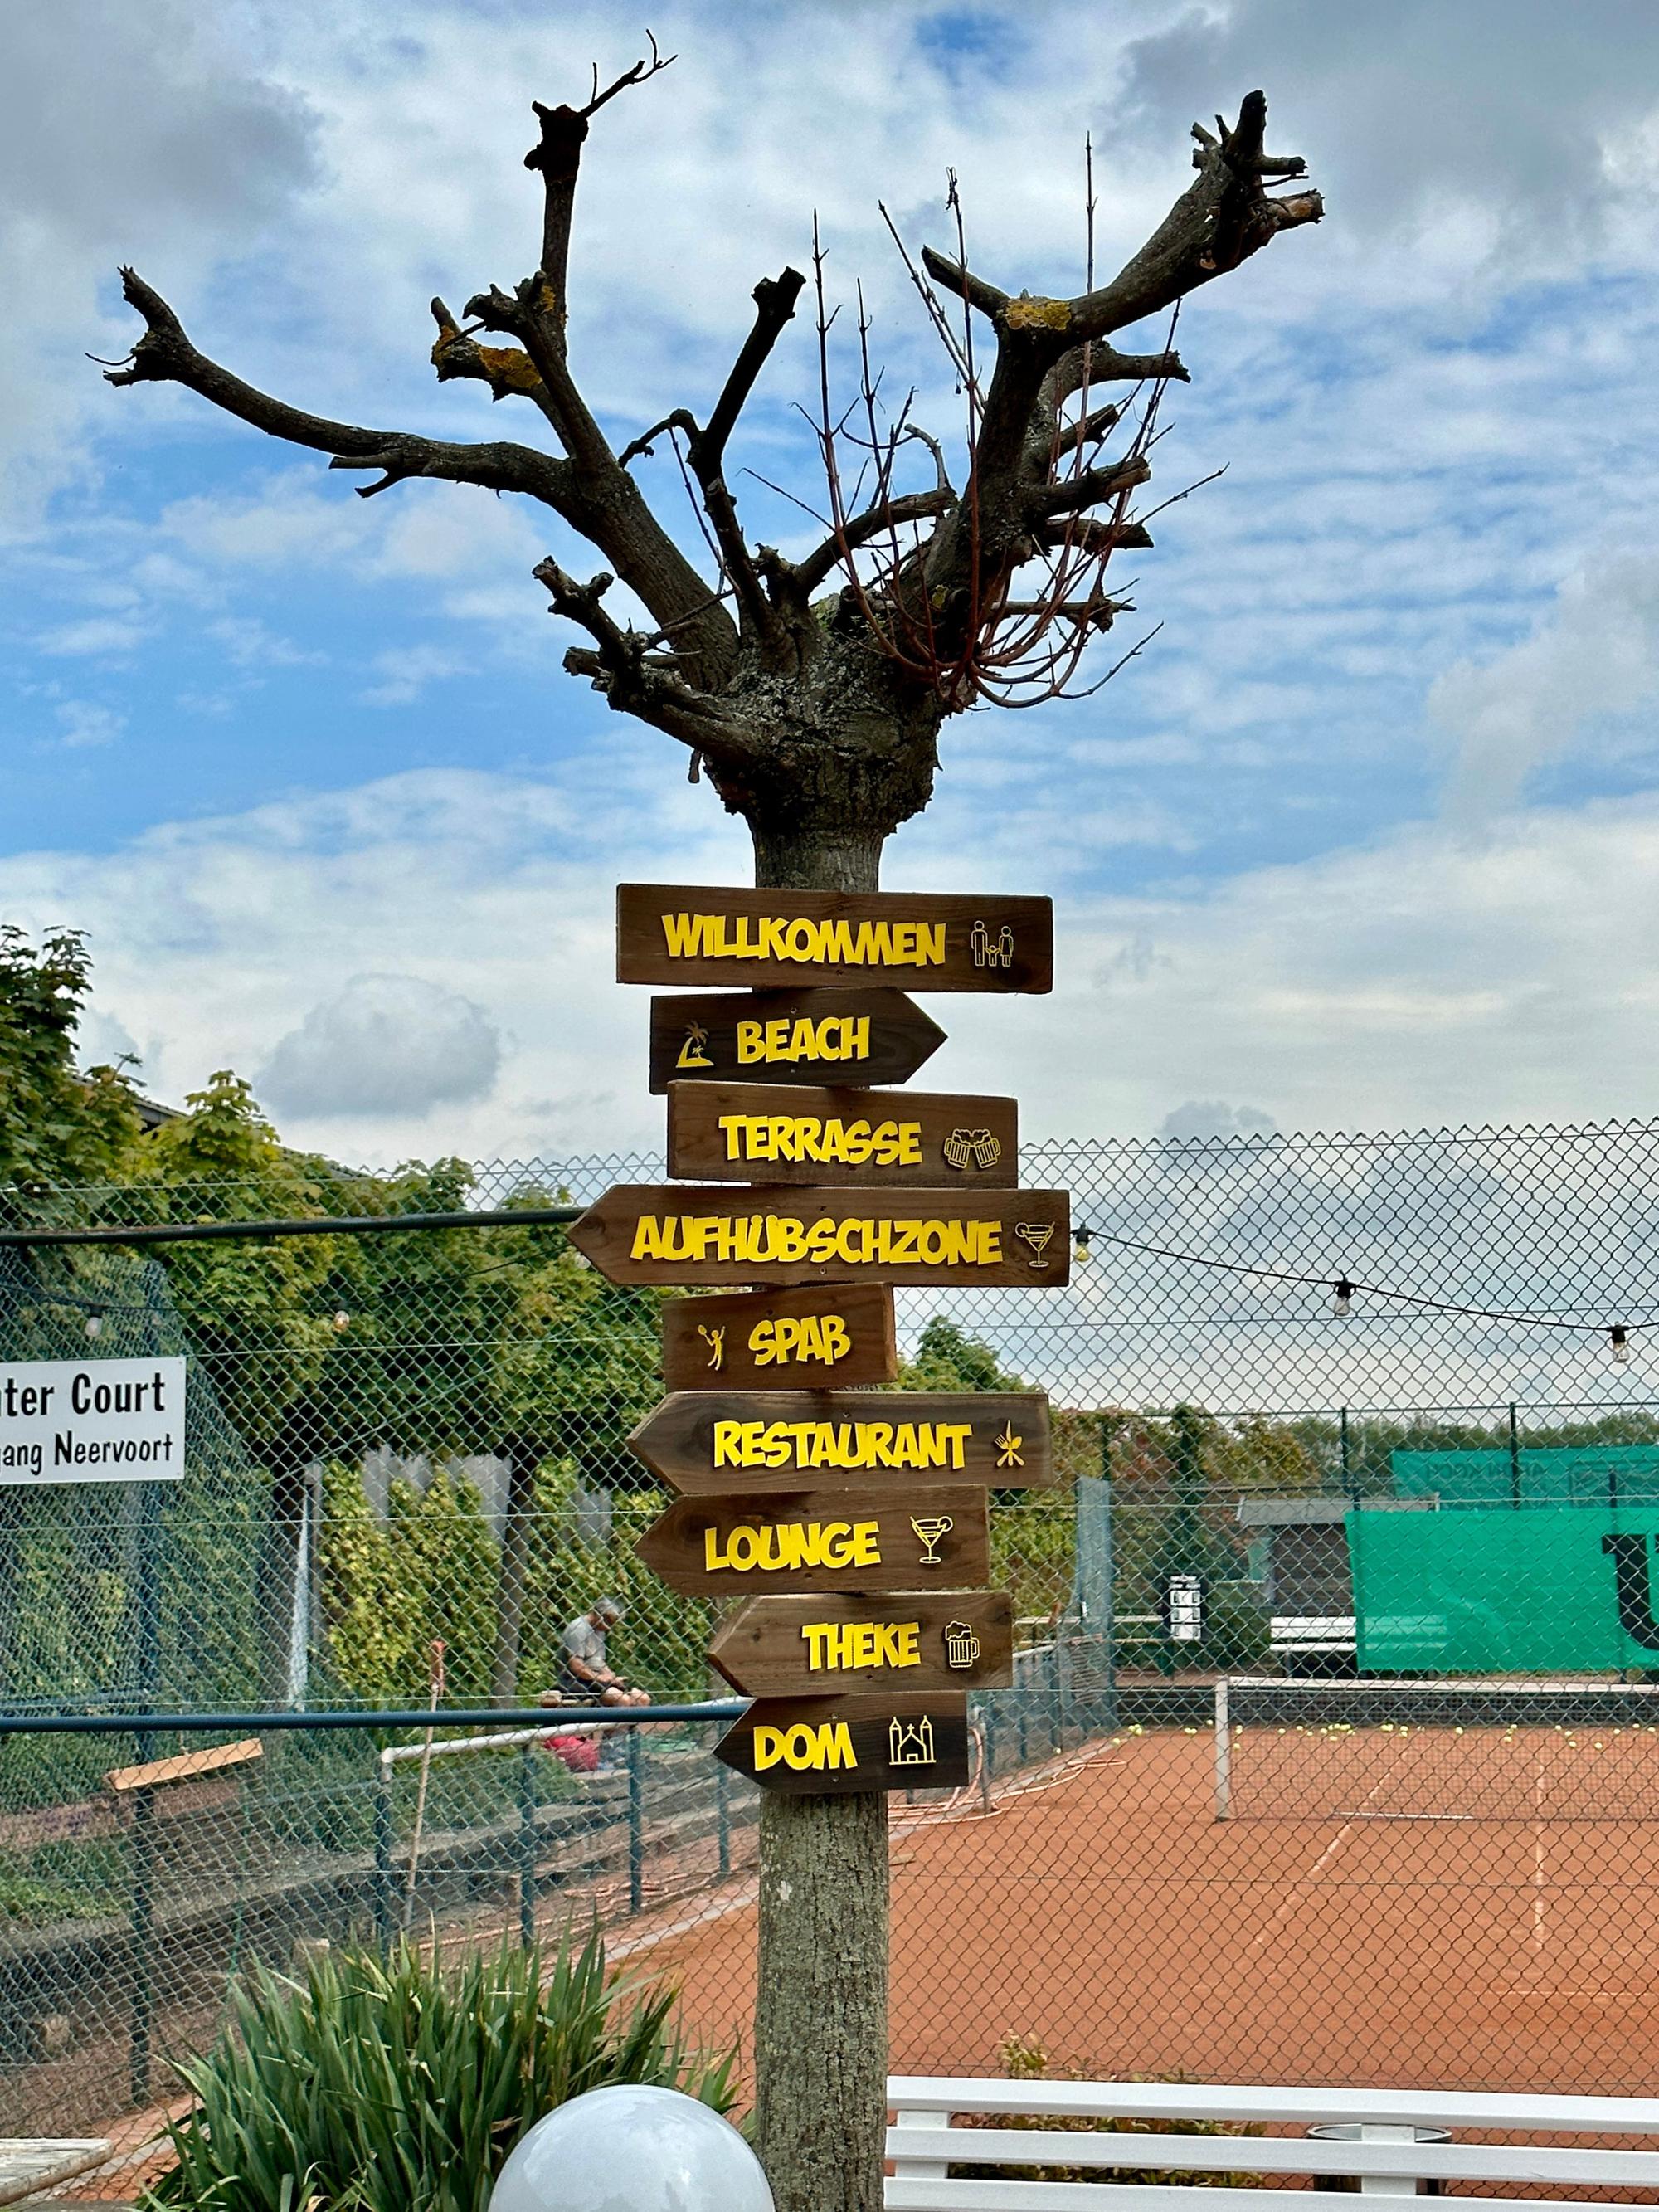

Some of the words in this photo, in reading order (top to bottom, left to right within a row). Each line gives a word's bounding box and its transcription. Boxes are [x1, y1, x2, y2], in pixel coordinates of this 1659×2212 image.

[661, 913, 946, 967] WILLKOMMEN
[737, 1016, 870, 1064] BEACH
[718, 1114, 923, 1166] TERRASSE
[630, 1214, 1002, 1265] AUFHÜBSCHZONE
[0, 1377, 55, 1417] ter
[71, 1372, 165, 1415] Court
[0, 1444, 42, 1476] ang
[54, 1430, 173, 1466] Neervoort
[714, 1420, 972, 1469] RESTAURANT
[705, 1520, 882, 1571] LOUNGE
[802, 1621, 921, 1670] THEKE
[754, 1722, 858, 1771] DOM
